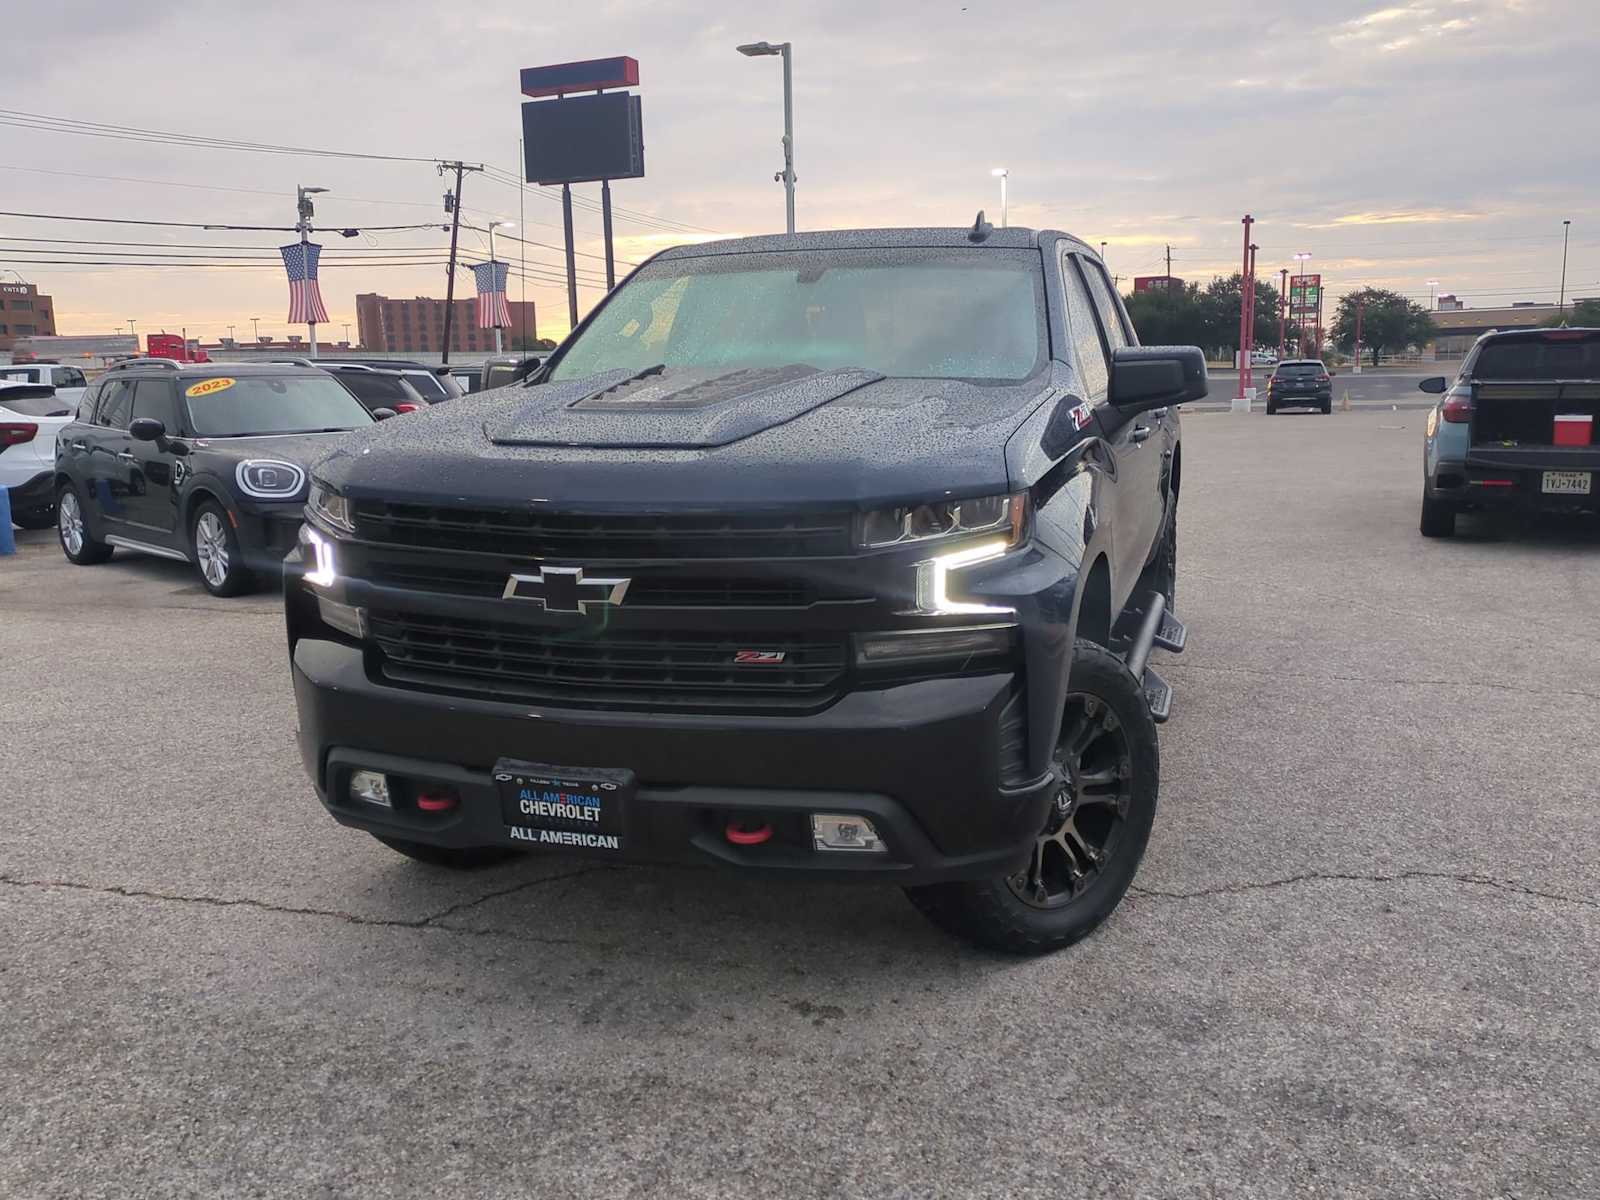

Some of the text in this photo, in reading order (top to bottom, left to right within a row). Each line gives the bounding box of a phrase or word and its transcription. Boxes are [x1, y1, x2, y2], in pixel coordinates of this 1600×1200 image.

[192, 379, 231, 394] 2023
[734, 651, 786, 663] Z71
[520, 789, 600, 807] ALL AMERICAN
[519, 799, 601, 822] CHEVROLET
[510, 826, 619, 849] ALL AMERICAN
